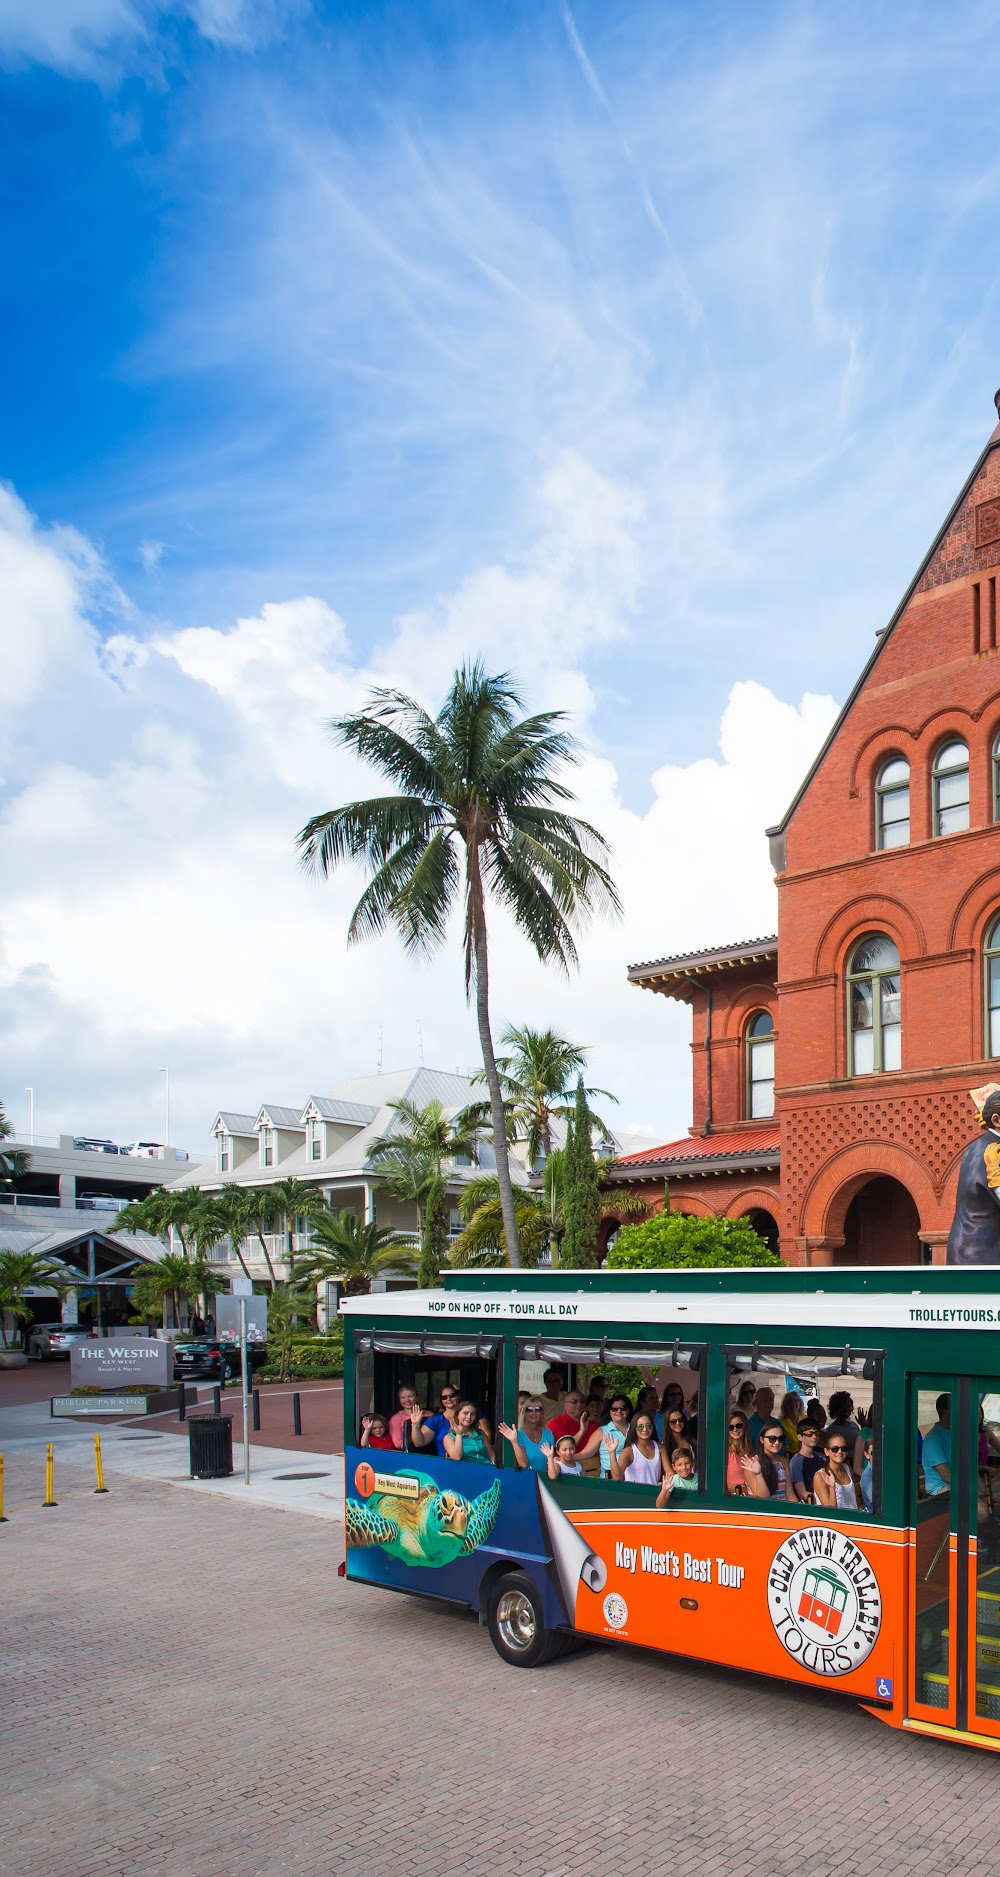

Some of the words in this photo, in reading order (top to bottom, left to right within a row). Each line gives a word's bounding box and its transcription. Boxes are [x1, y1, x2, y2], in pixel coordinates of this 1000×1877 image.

[428, 1302, 446, 1312] HOP
[448, 1302, 461, 1312] ON
[463, 1303, 482, 1313] HOP
[484, 1303, 501, 1313] OFF
[509, 1304, 535, 1314] TOUR
[538, 1304, 556, 1315] ALL
[558, 1305, 579, 1315] DAY
[79, 1347, 105, 1359] THE
[107, 1347, 159, 1358] WESTIN
[362, 1473, 367, 1493] 1
[385, 1480, 396, 1488] West
[397, 1481, 417, 1491] Aquarium
[615, 1541, 638, 1574] Key
[640, 1545, 680, 1578] West's
[683, 1552, 712, 1584] Best
[715, 1557, 745, 1589] Tour
[769, 1552, 795, 1593] OLD
[787, 1529, 837, 1562] TOWN
[839, 1540, 879, 1644] TROLLEY
[775, 1607, 853, 1674] TOURS
